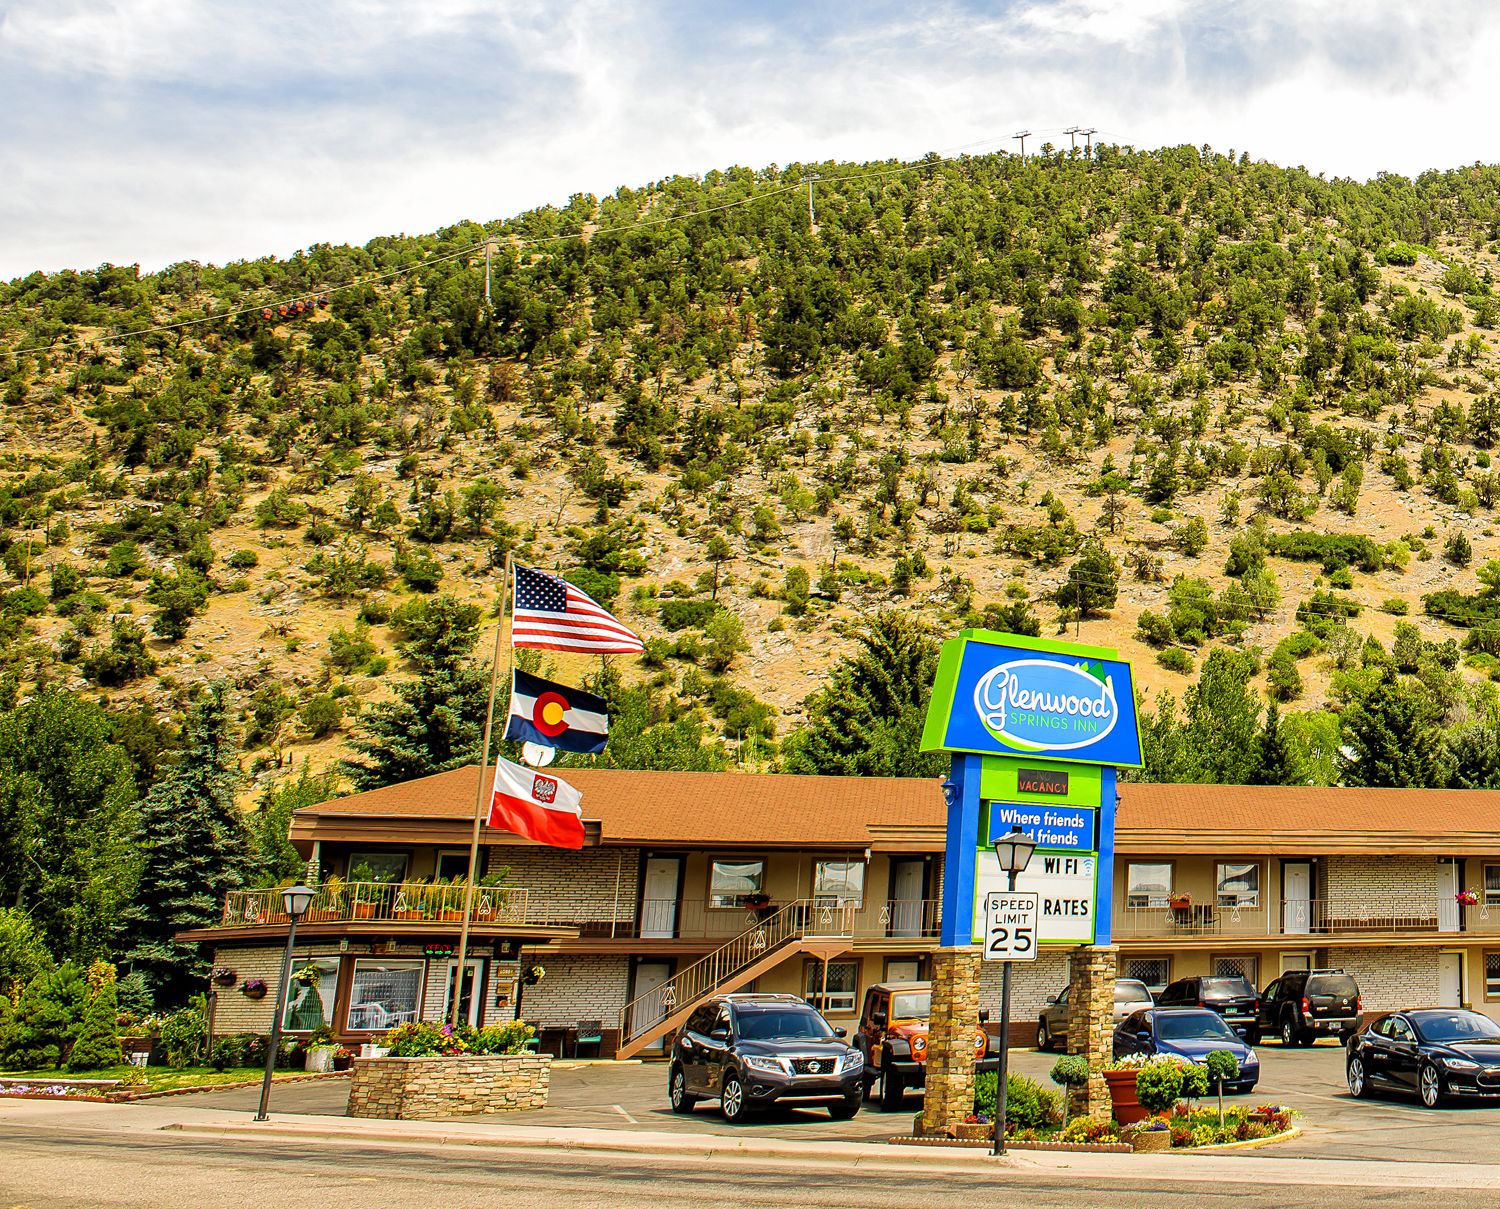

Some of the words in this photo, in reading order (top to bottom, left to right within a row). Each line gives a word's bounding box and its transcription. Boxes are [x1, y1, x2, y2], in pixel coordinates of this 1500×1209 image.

[983, 668, 1111, 731] Glenwood
[1011, 711, 1069, 730] SPRINGS
[1073, 718, 1098, 733] INN
[1019, 781, 1068, 793] VACANCY
[1000, 809, 1041, 825] Where
[1044, 811, 1085, 828] friends
[1037, 828, 1079, 845] friends
[1045, 857, 1061, 874] WI
[1065, 858, 1078, 875] FI
[992, 900, 1034, 910] SPEED
[1044, 899, 1089, 916] RATES
[995, 914, 1029, 924] LIMIT
[990, 927, 1033, 952] 25
